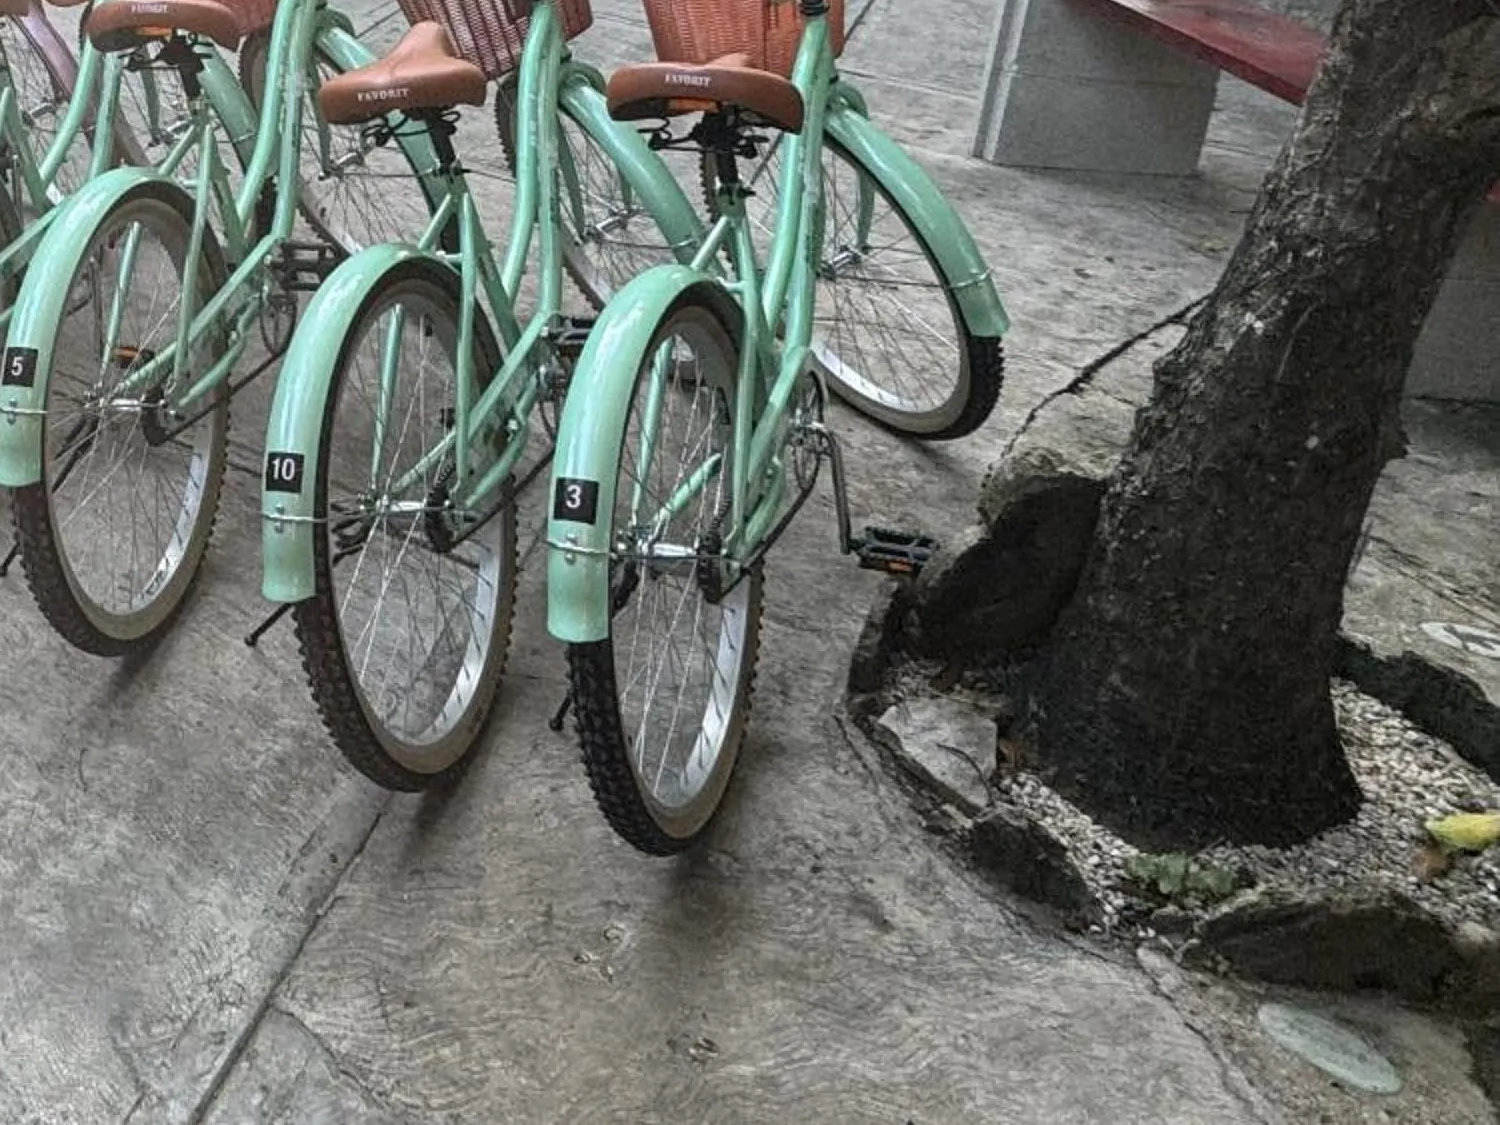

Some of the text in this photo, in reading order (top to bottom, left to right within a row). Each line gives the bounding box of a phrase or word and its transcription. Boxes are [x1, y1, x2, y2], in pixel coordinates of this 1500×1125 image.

[357, 87, 409, 102] FAVORIT
[11, 356, 23, 376] 5
[271, 457, 296, 482] 10
[565, 484, 581, 509] 3
